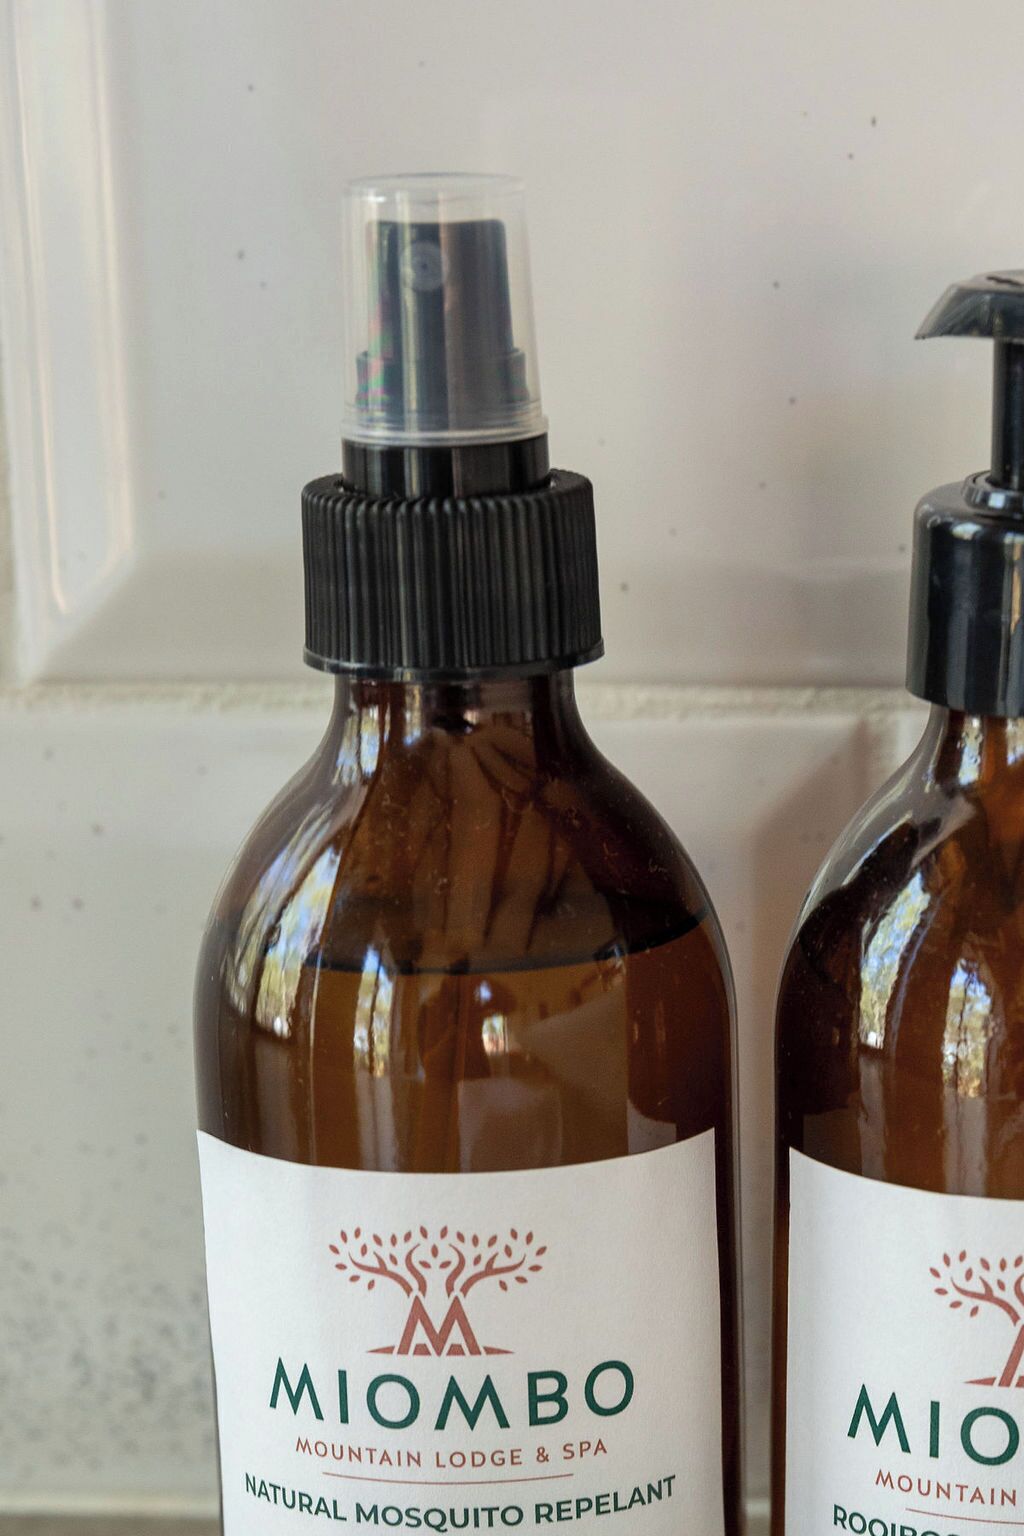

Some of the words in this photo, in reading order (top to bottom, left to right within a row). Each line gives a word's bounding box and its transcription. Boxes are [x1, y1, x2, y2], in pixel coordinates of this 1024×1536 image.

[269, 1356, 634, 1432] MIOMBO
[295, 1436, 422, 1469] MOUNTAIN
[435, 1448, 523, 1469] LODGE
[535, 1446, 550, 1465] &
[562, 1438, 608, 1461] SPA
[244, 1472, 348, 1523] NATURAL
[354, 1502, 525, 1535] MOSQUITO
[534, 1474, 677, 1527] REPELANT
[874, 1468, 1017, 1509] MOUNTAIN
